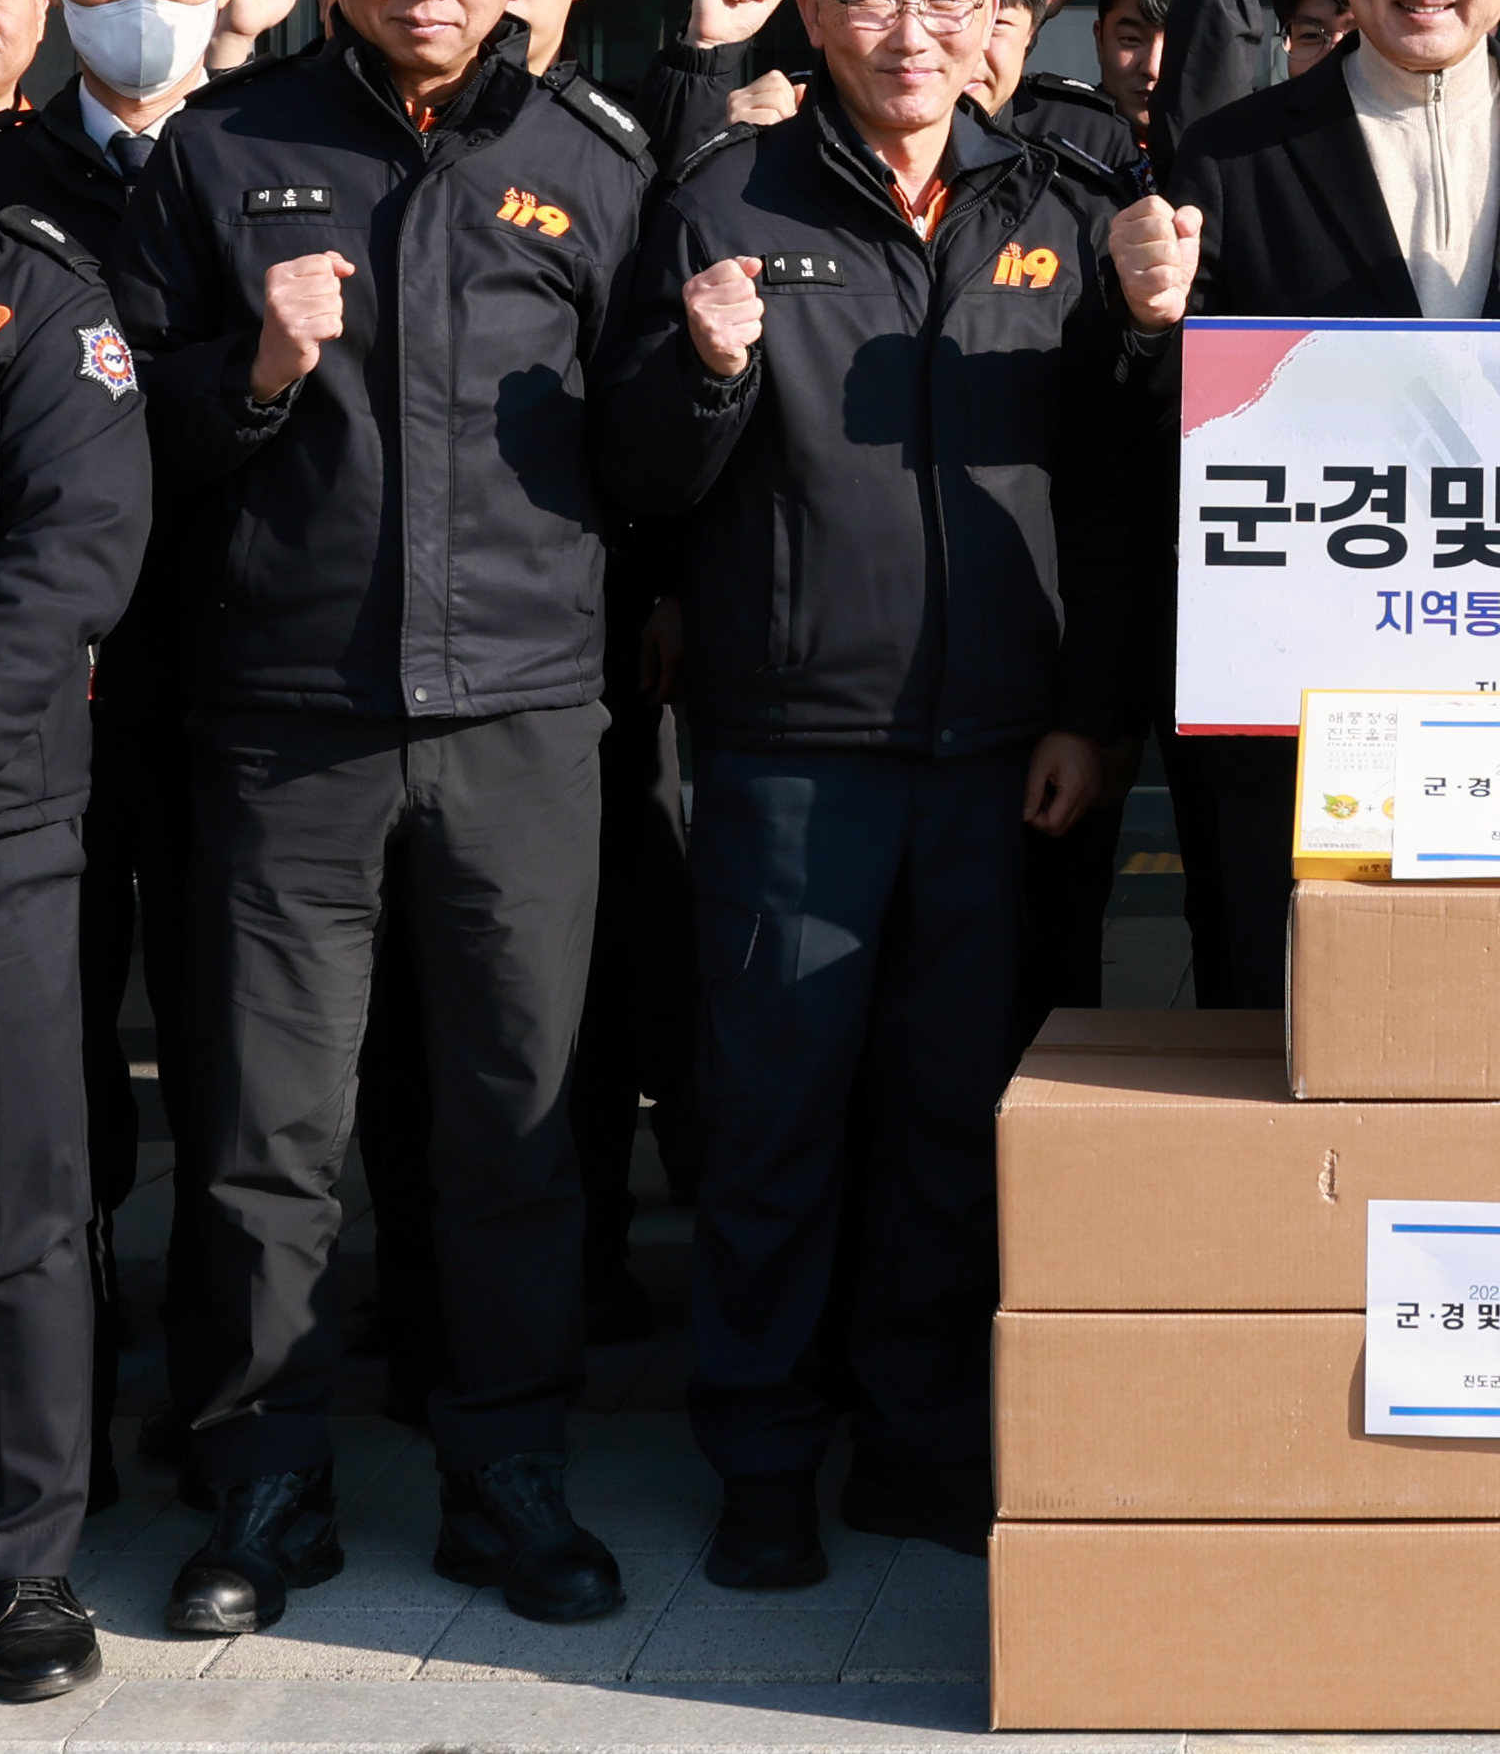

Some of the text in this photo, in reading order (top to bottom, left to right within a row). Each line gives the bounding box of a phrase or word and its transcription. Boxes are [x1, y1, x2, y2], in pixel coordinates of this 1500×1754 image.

[496, 205, 571, 238] 119
[992, 248, 1060, 289] 119
[1200, 465, 1407, 569] 군·경
[1425, 778, 1490, 797] 군·경
[1397, 1303, 1463, 1330] 군·경
[1479, 1304, 1500, 1329] 및
[1464, 1376, 1500, 1388] 진도군
